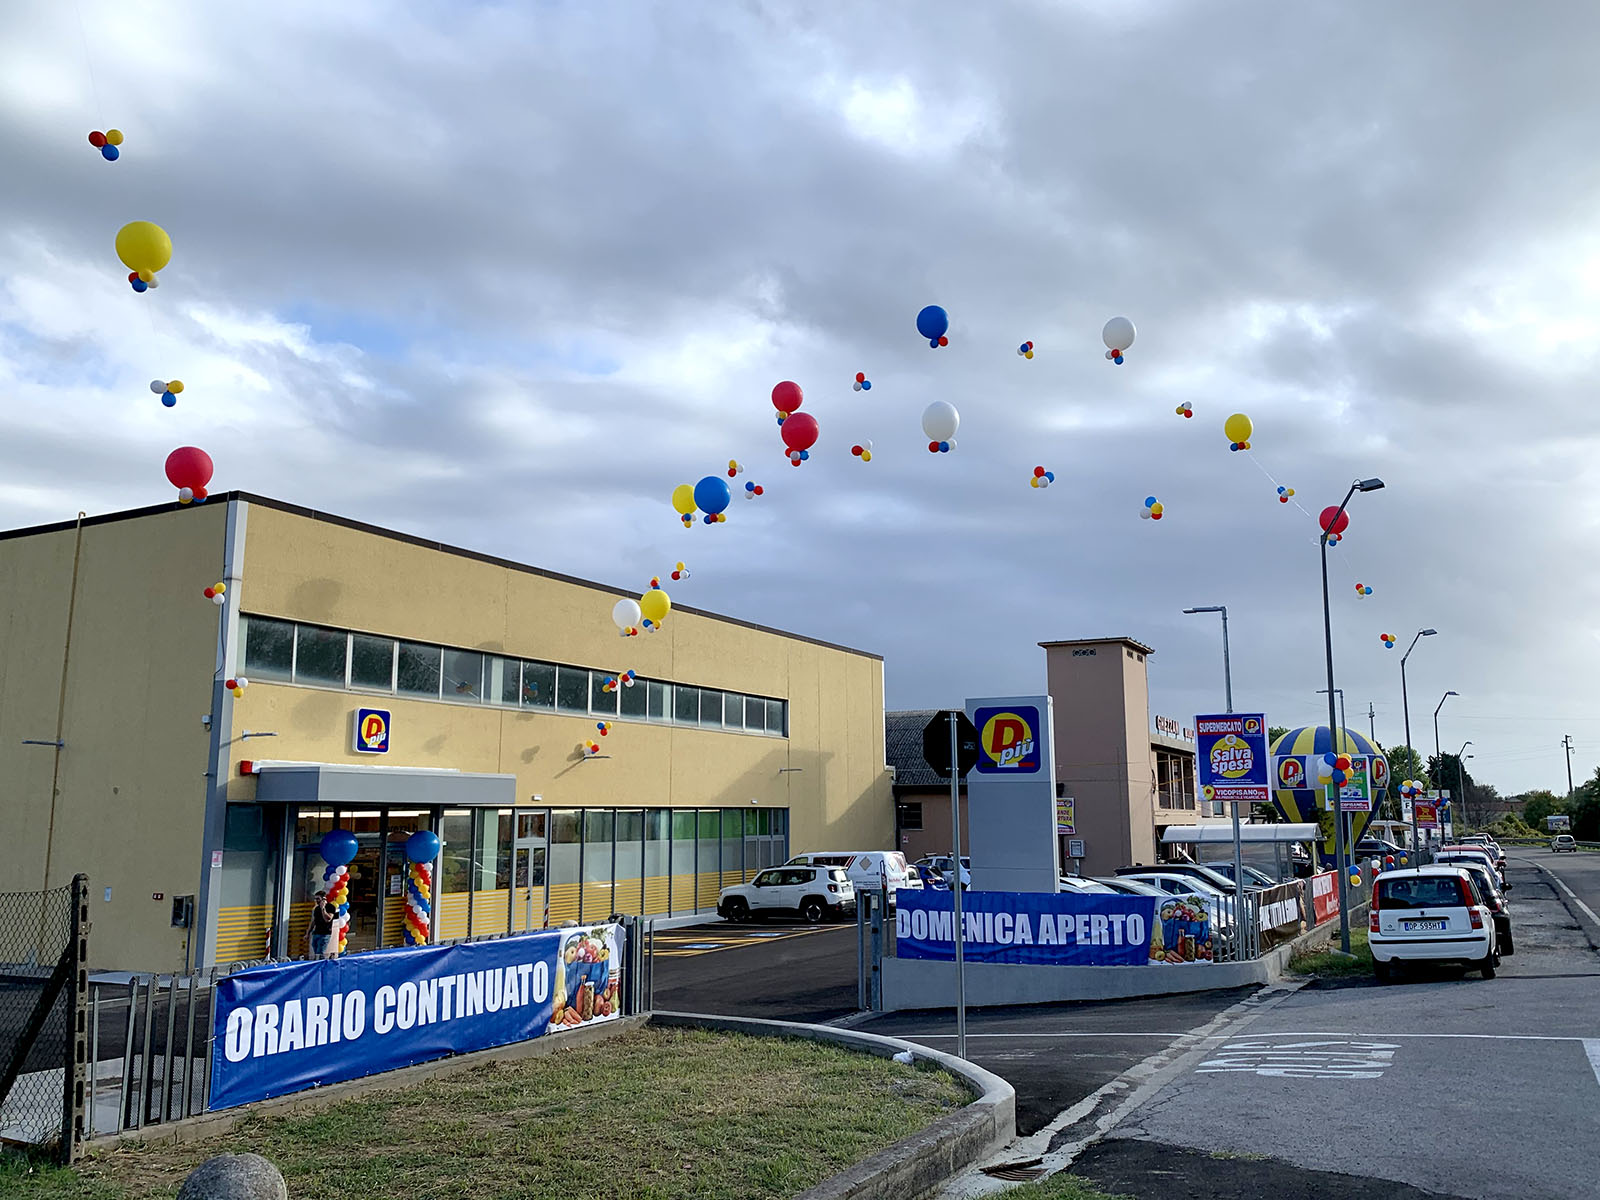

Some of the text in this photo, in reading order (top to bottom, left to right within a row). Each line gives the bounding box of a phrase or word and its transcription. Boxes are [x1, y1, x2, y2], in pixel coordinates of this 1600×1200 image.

[366, 717, 383, 739] D
[1198, 722, 1242, 733] SUPERMERCATO
[991, 719, 1035, 766] D più
[1213, 747, 1252, 763] Salva
[1211, 759, 1252, 775] spesa
[896, 908, 1146, 946] DOMENICA APERTO
[224, 960, 549, 1063] ORARIO CONTINUATO
